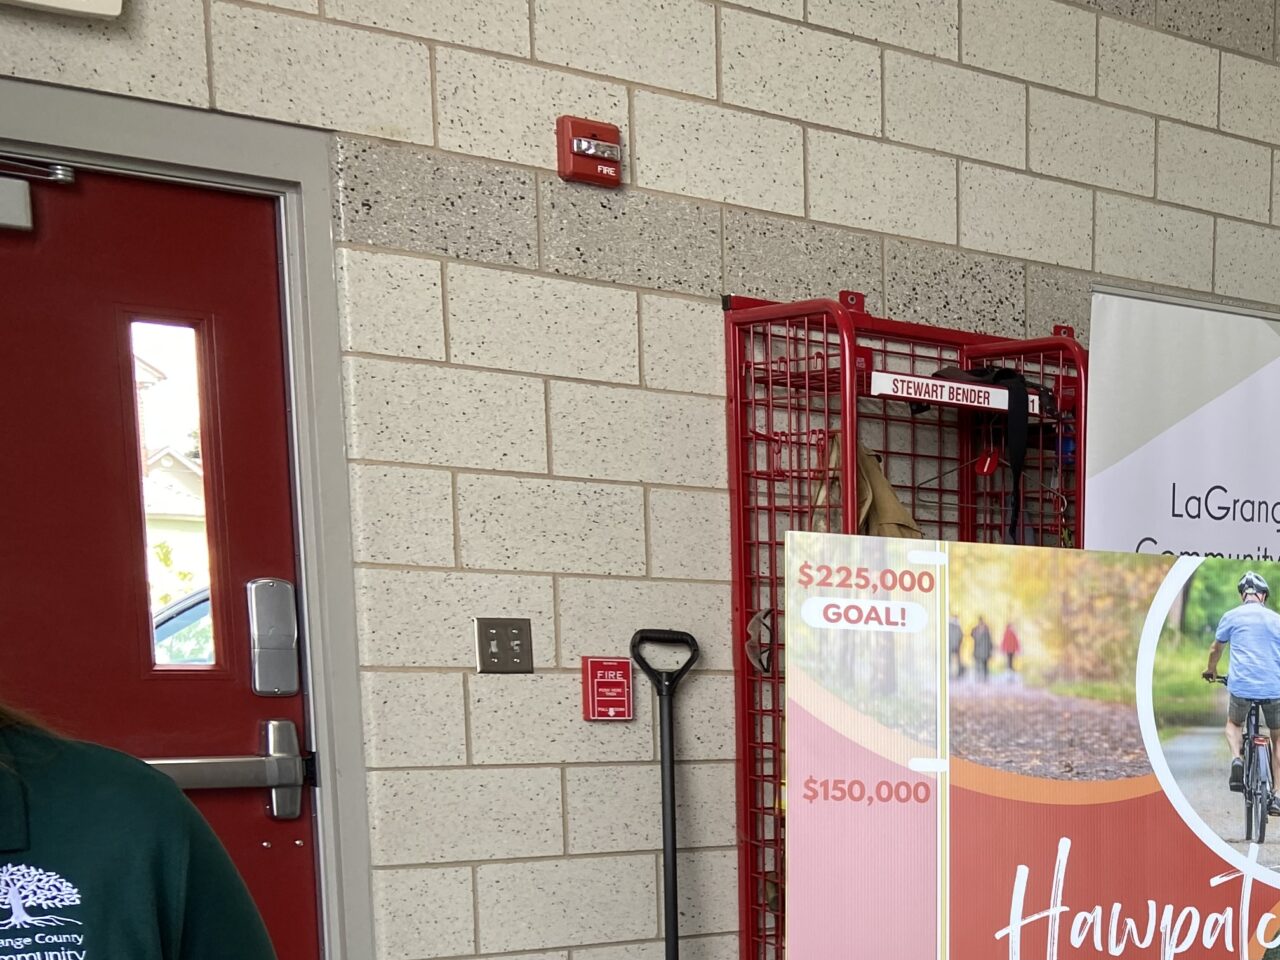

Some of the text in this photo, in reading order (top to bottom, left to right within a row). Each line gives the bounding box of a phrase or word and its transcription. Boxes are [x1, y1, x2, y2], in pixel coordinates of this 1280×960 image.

[598, 165, 616, 176] FIRE
[892, 378, 945, 399] STEWART
[949, 385, 990, 406] BENDER
[798, 560, 935, 594] $225,000
[822, 603, 907, 627] GOAL!
[597, 670, 624, 680] FIRE
[802, 775, 931, 806] $150,000
[35, 933, 84, 946] County
